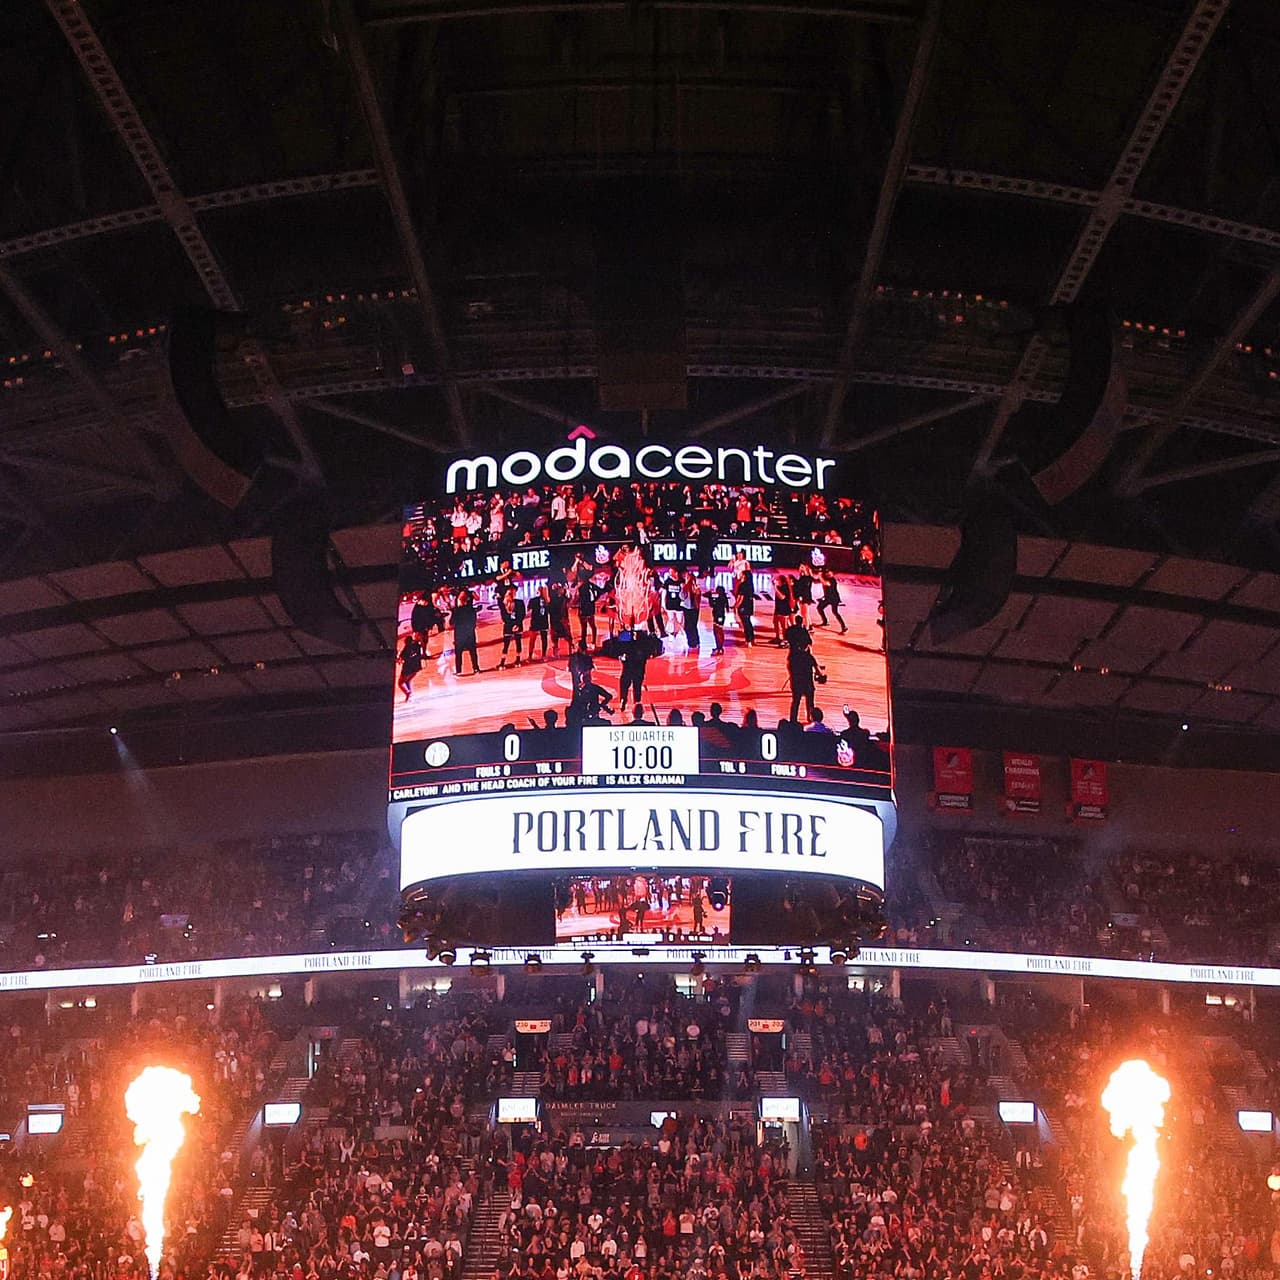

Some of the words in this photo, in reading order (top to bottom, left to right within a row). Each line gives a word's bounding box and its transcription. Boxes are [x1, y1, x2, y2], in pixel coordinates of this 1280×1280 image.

[512, 550, 550, 570] FIRE
[609, 731, 625, 742] 1ST
[628, 731, 675, 742] QUARTER
[504, 733, 520, 761] 0
[761, 733, 777, 760] 0
[611, 745, 673, 770] 10:00
[476, 766, 500, 778] FOULS
[771, 764, 796, 776] FOULS
[442, 784, 461, 794] AND
[463, 782, 479, 792] THE
[481, 780, 505, 790] HEAD
[507, 779, 535, 788] COACH
[538, 778, 549, 787] OF
[552, 777, 575, 786] YOUR
[577, 776, 598, 786] FIRE
[606, 775, 617, 785] IS
[618, 775, 641, 785] ALEX
[512, 808, 721, 854] PORTLAND
[737, 810, 827, 857] FIRE
[303, 955, 349, 968] PORTLAND
[350, 953, 372, 966] FIRE
[899, 952, 920, 963] FIRE
[1026, 957, 1070, 970] PORTLAND
[1071, 958, 1092, 972] FIRE
[139, 966, 180, 978] PORTLAND
[181, 963, 201, 975] FIRE
[1189, 967, 1232, 980] PORTLAND
[1233, 969, 1254, 982] FIRE
[8, 974, 27, 986] FIRE
